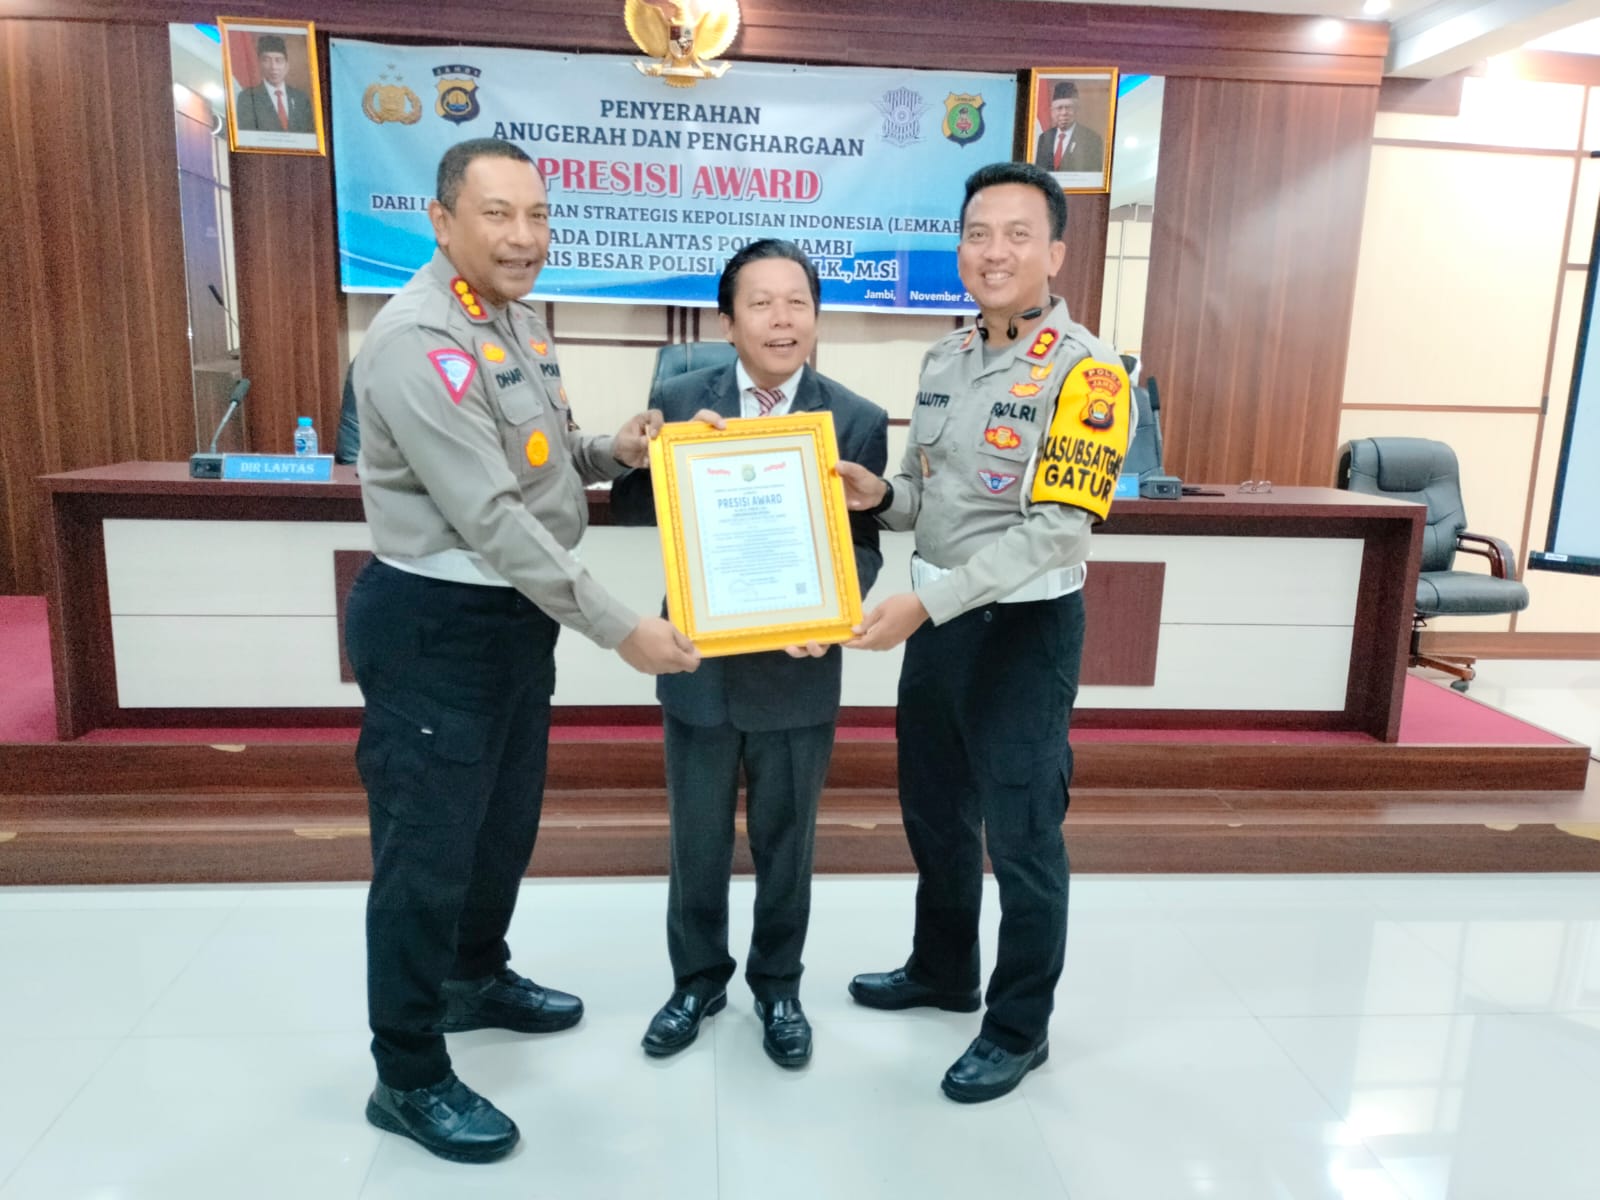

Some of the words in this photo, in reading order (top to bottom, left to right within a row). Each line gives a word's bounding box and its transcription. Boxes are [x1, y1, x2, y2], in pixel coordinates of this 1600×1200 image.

[600, 99, 761, 125] PENYERAHAN
[492, 121, 627, 147] ANUGERAH
[632, 128, 682, 149] DAN
[687, 131, 865, 157] PENGHARGAAN
[537, 157, 680, 196] PRESISI
[692, 164, 820, 201] AWARD
[372, 194, 416, 211] DARI
[583, 204, 678, 223] STRATEGIS
[682, 209, 786, 228] KEPOLISIAN
[790, 214, 884, 231] INDONESIA
[595, 229, 713, 251] DIRLANTAS
[577, 251, 644, 270] BESAR
[652, 254, 715, 273] POLISI
[864, 289, 897, 301] Jambi,
[909, 290, 961, 302] November
[240, 462, 262, 473] DIR
[264, 462, 315, 474] LANTAS
[1044, 463, 1113, 504] GATUR
[718, 497, 750, 509] PRESISI
[752, 494, 782, 505] AWARD
